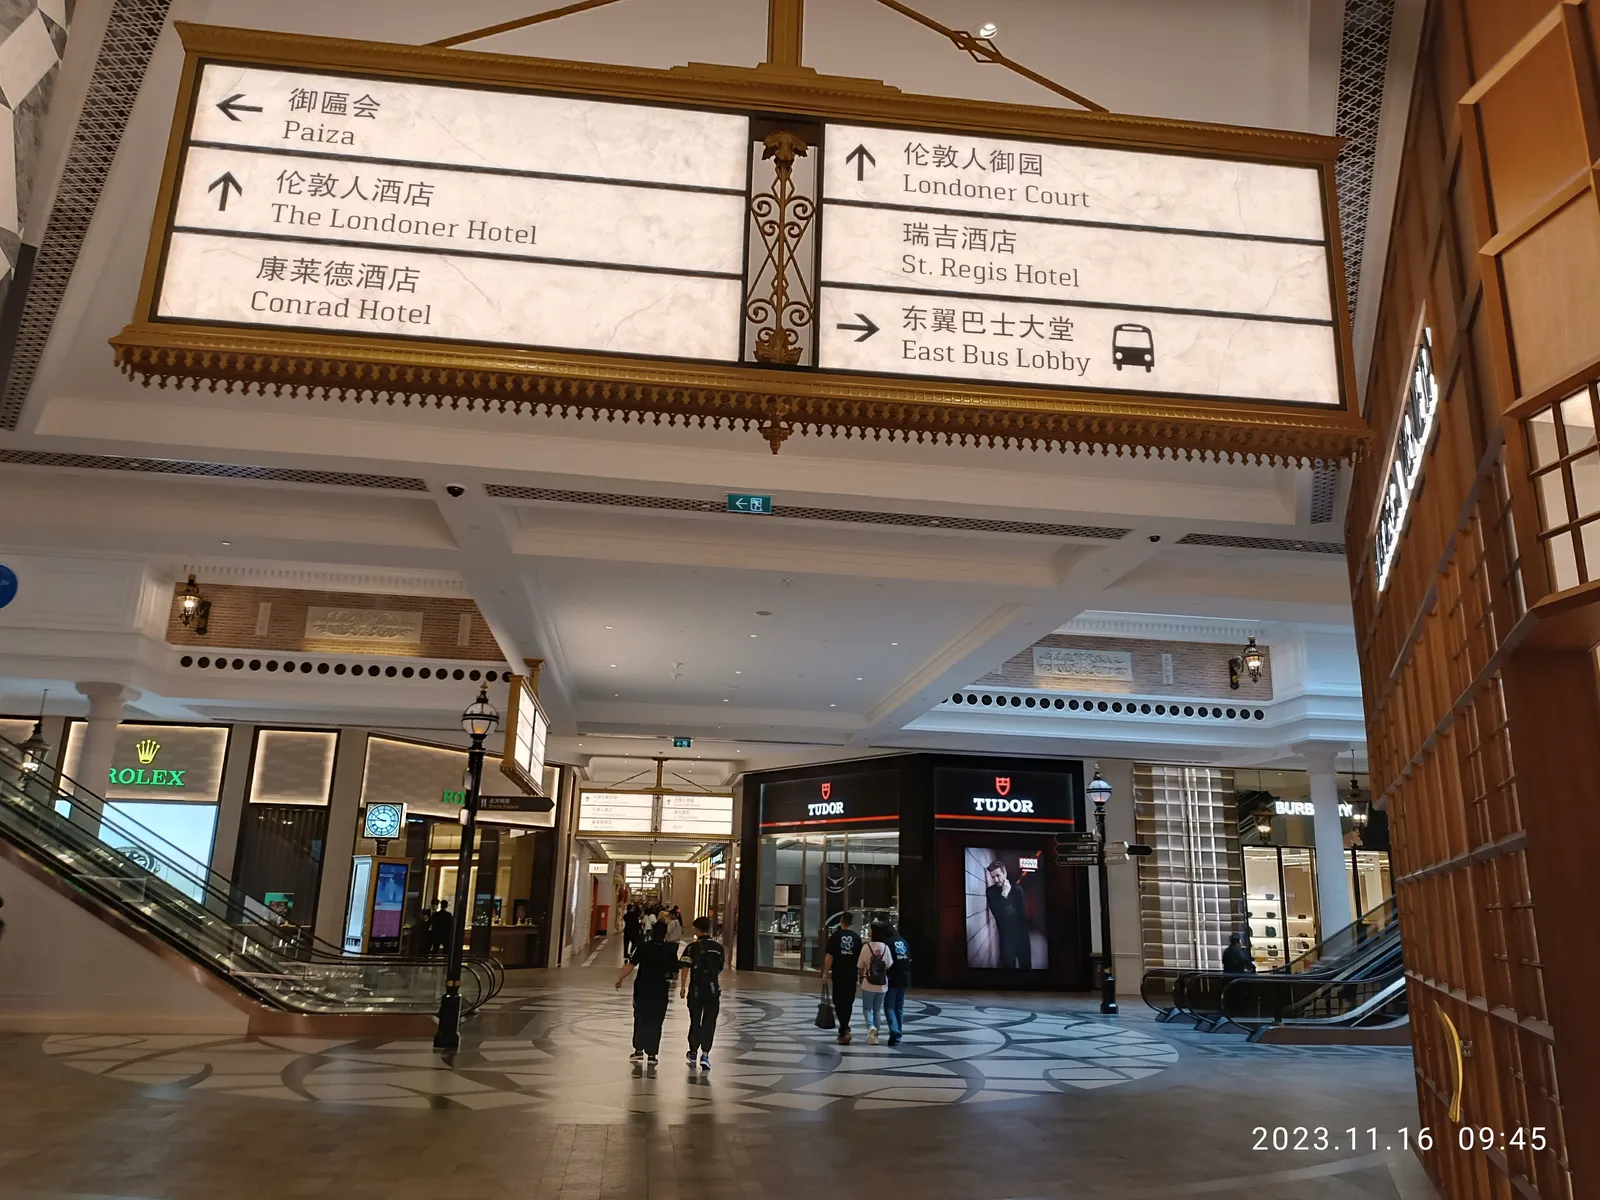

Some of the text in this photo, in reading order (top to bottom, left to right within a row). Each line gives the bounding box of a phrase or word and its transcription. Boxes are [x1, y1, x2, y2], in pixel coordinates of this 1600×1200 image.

[289, 88, 381, 120] 御匾会
[282, 120, 355, 146] Paiza
[903, 142, 1043, 177] 伦敦人御园
[276, 169, 435, 206] 伦敦人酒店
[903, 173, 1091, 208] Londoner Court
[271, 203, 537, 246] The Londoner Hotel
[903, 221, 1017, 255] 瑞吉酒店
[256, 255, 421, 292] 康莱德酒店
[902, 254, 1079, 289] St. Regis Hotel
[251, 290, 432, 326] Conrad Hotel
[902, 305, 1075, 342] 东翼巴士大堂
[901, 339, 1091, 377] East Bus Lobby
[807, 801, 845, 816] TUDOR
[973, 797, 1035, 813] TUDOR
